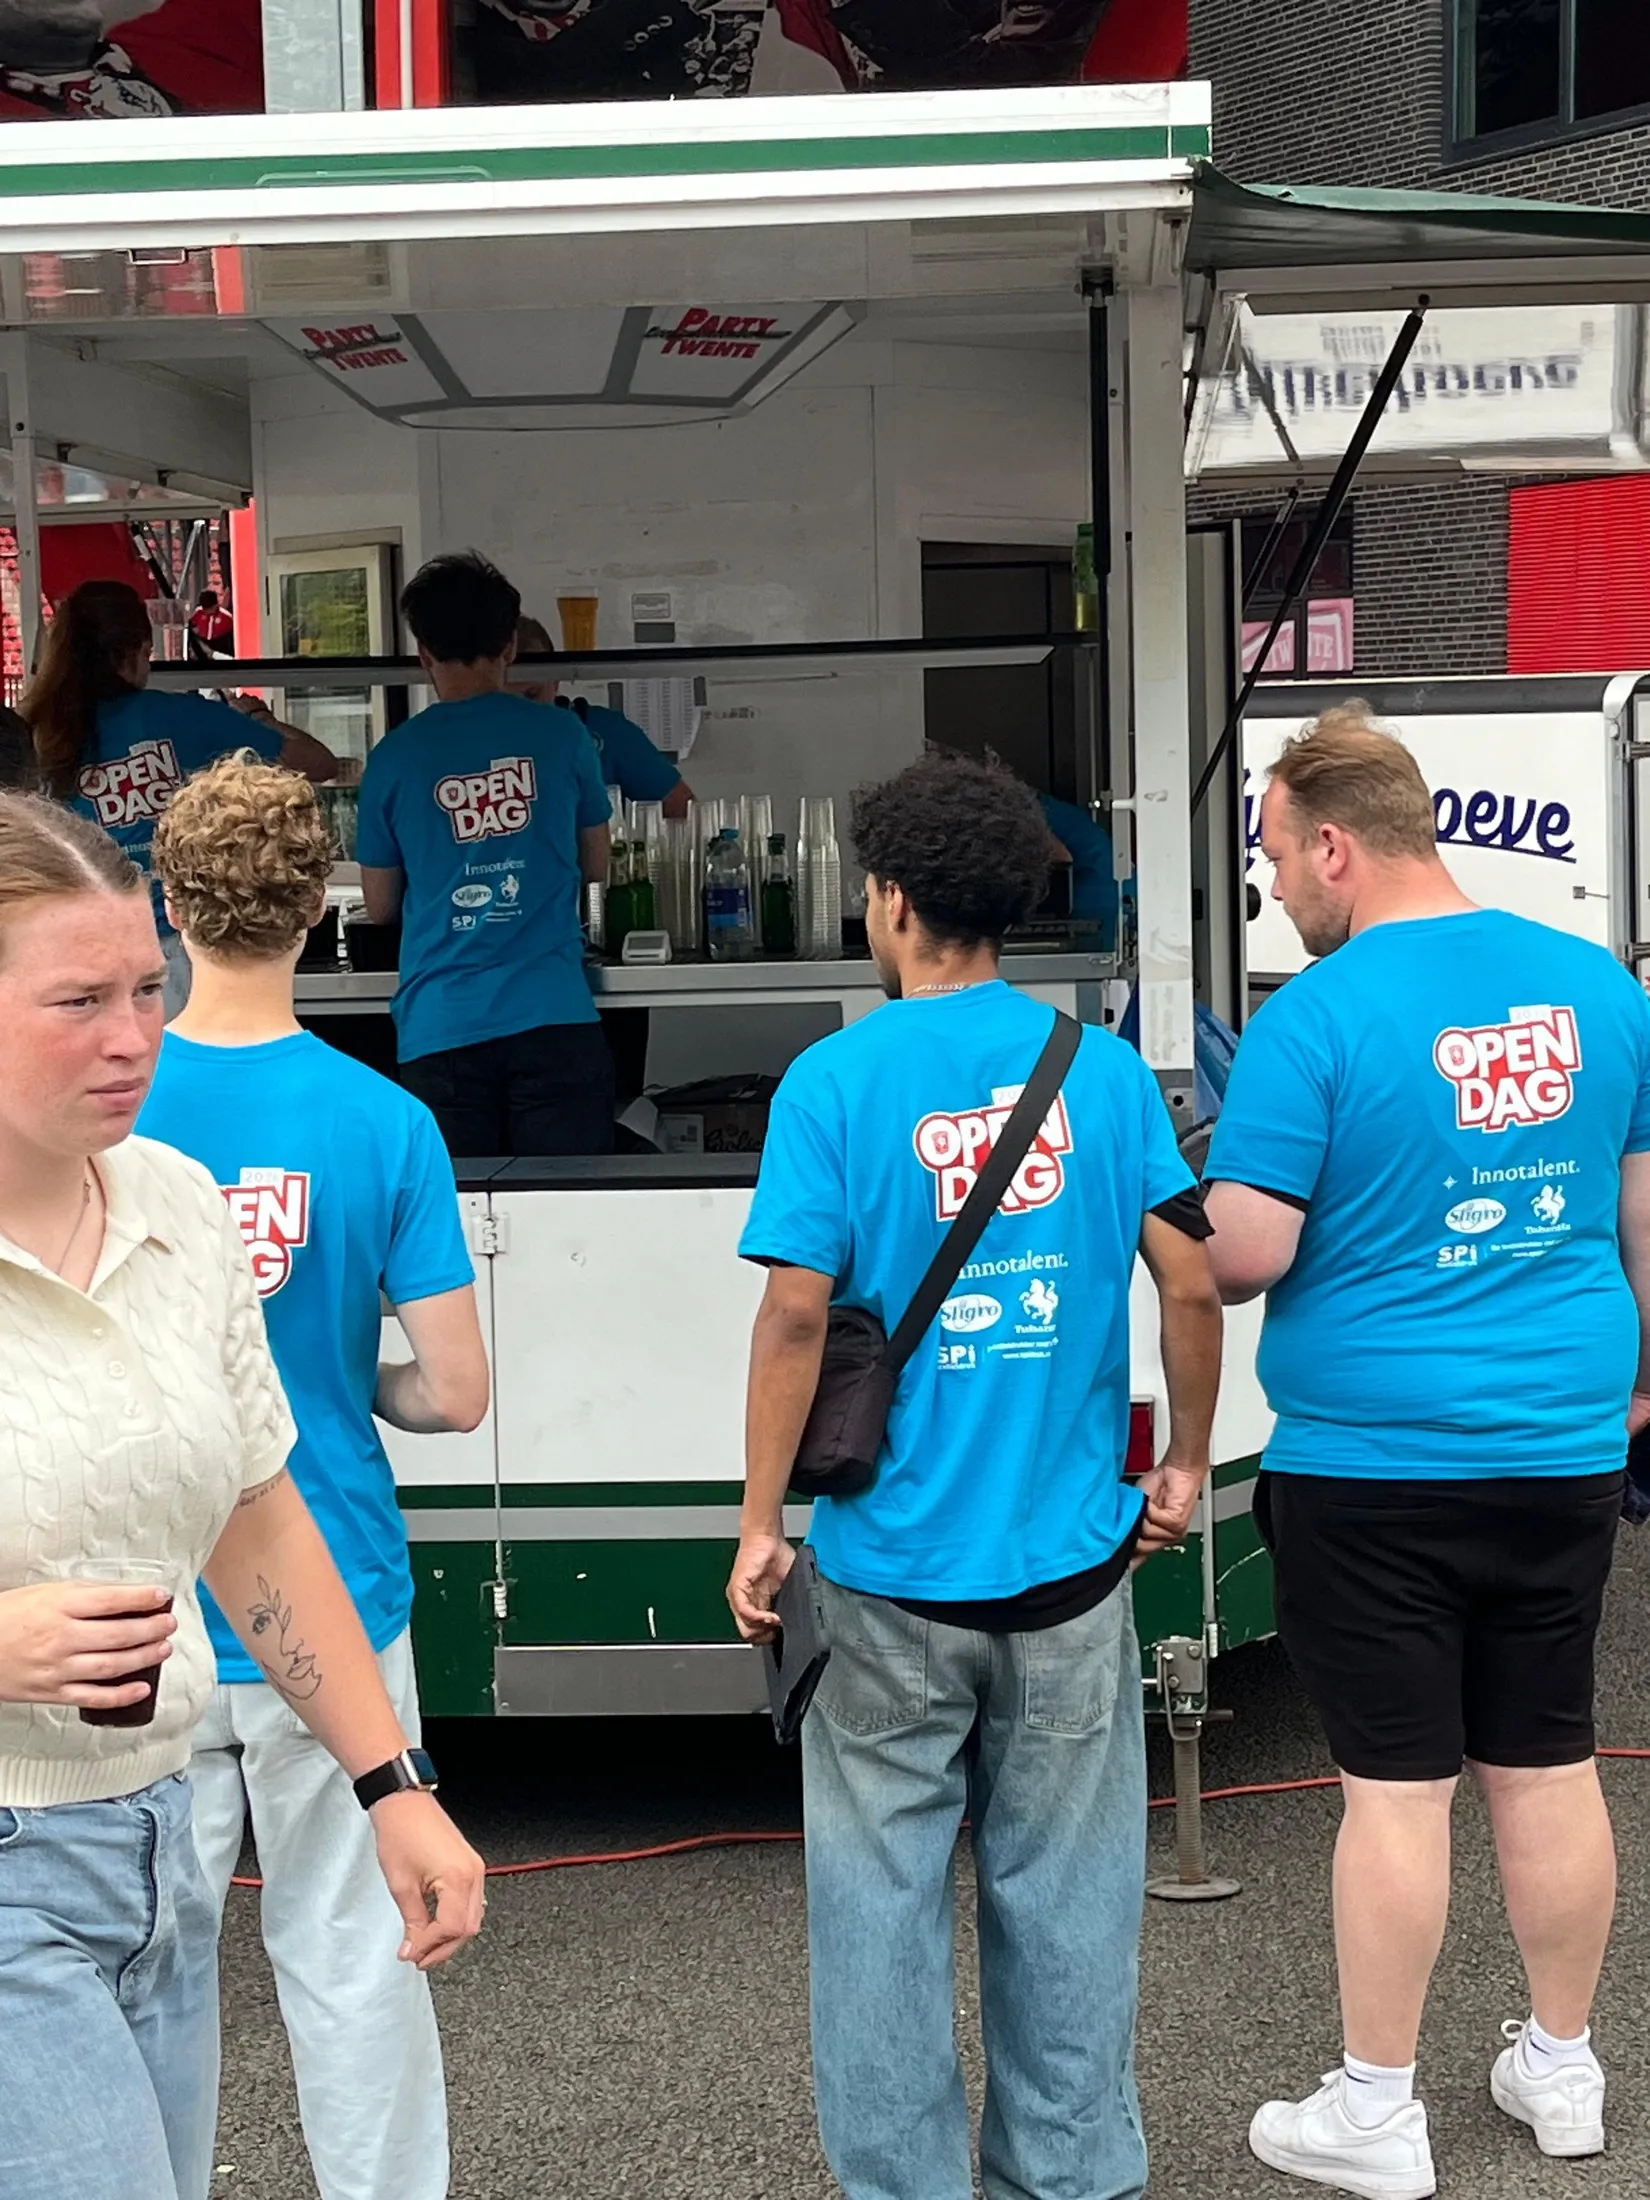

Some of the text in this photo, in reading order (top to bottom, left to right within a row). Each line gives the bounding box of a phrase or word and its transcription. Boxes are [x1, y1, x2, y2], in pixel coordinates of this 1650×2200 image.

[676, 308, 778, 336] PARTY
[661, 338, 761, 358] TWENTE
[79, 741, 178, 799] OPEN
[437, 760, 534, 810] OPEN
[96, 778, 174, 827] DAG
[453, 797, 528, 840] DAG
[1433, 788, 1575, 859] oeve
[1437, 1009, 1577, 1078] OPEN
[1460, 1068, 1570, 1128] DAG
[223, 1174, 307, 1245] EN
[938, 1152, 1064, 1219] DG
[1448, 1203, 1503, 1224] Sligro
[941, 1297, 999, 1322] Sligro
